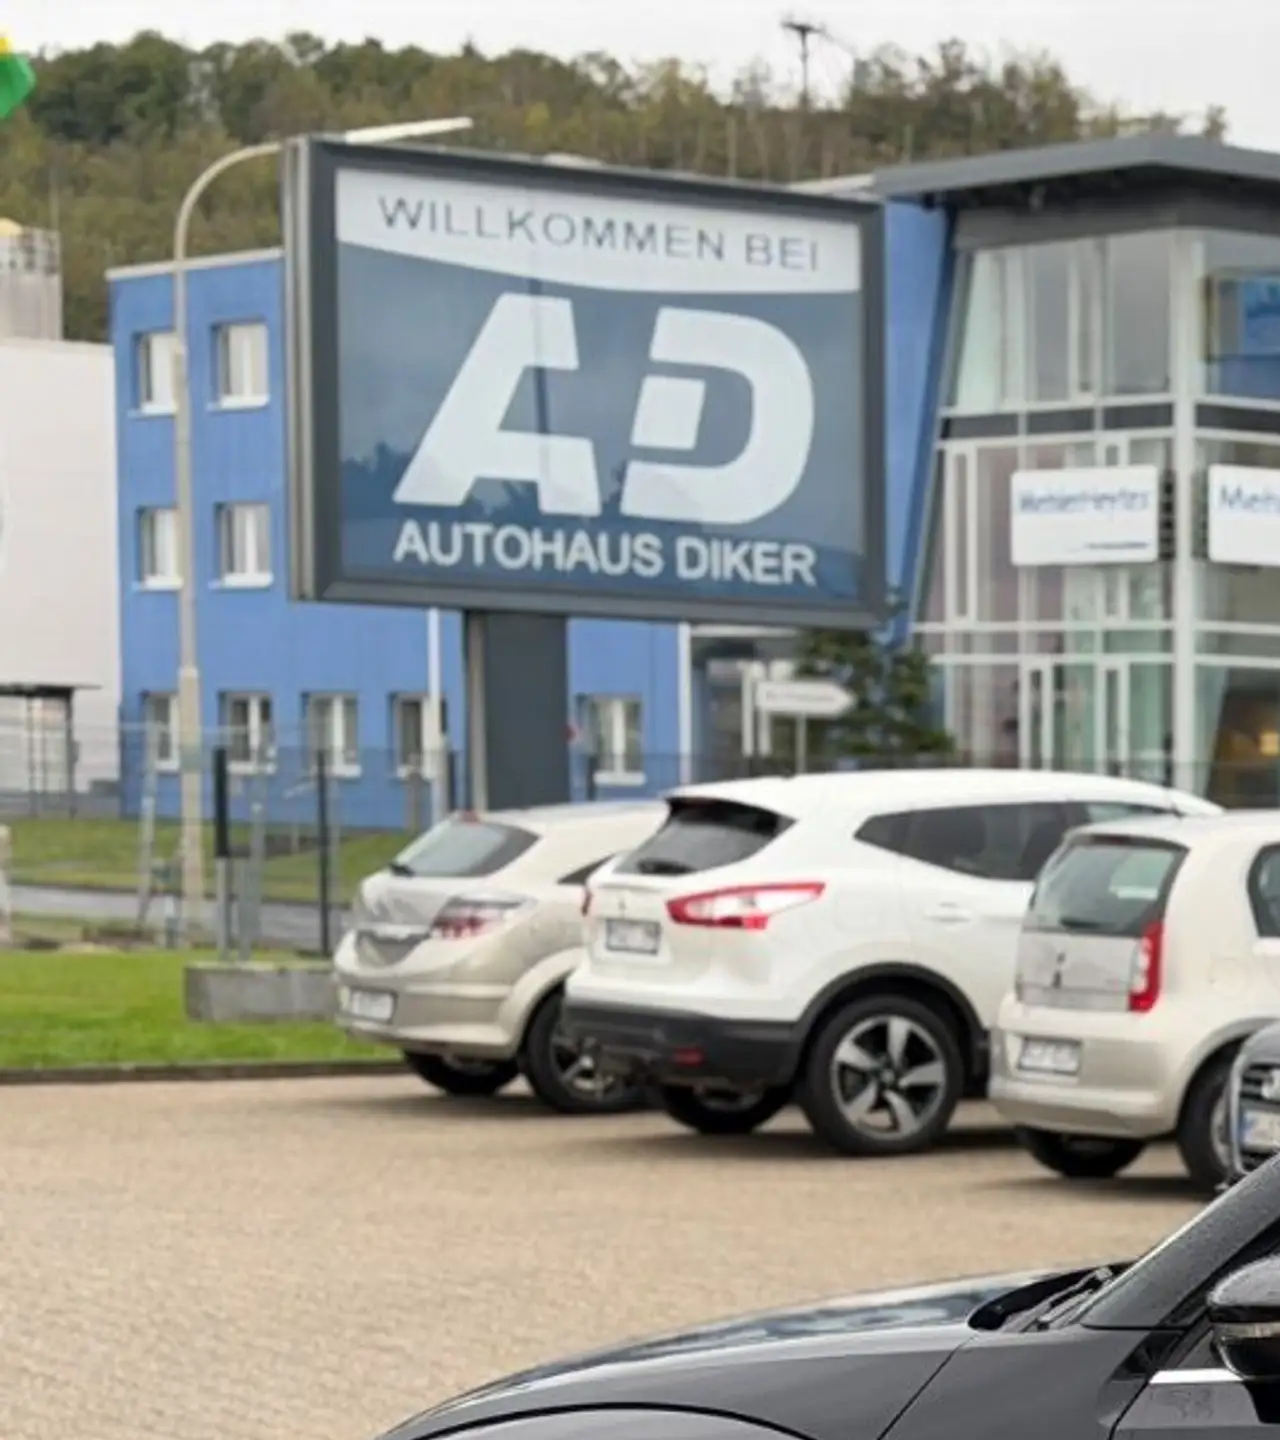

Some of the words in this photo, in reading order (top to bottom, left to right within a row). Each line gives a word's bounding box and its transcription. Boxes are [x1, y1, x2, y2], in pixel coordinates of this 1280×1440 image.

[377, 195, 724, 262] WILLKOMMEN
[745, 233, 820, 272] BEI
[393, 519, 663, 578] AUTOHAUS
[676, 538, 818, 586] DIKER
